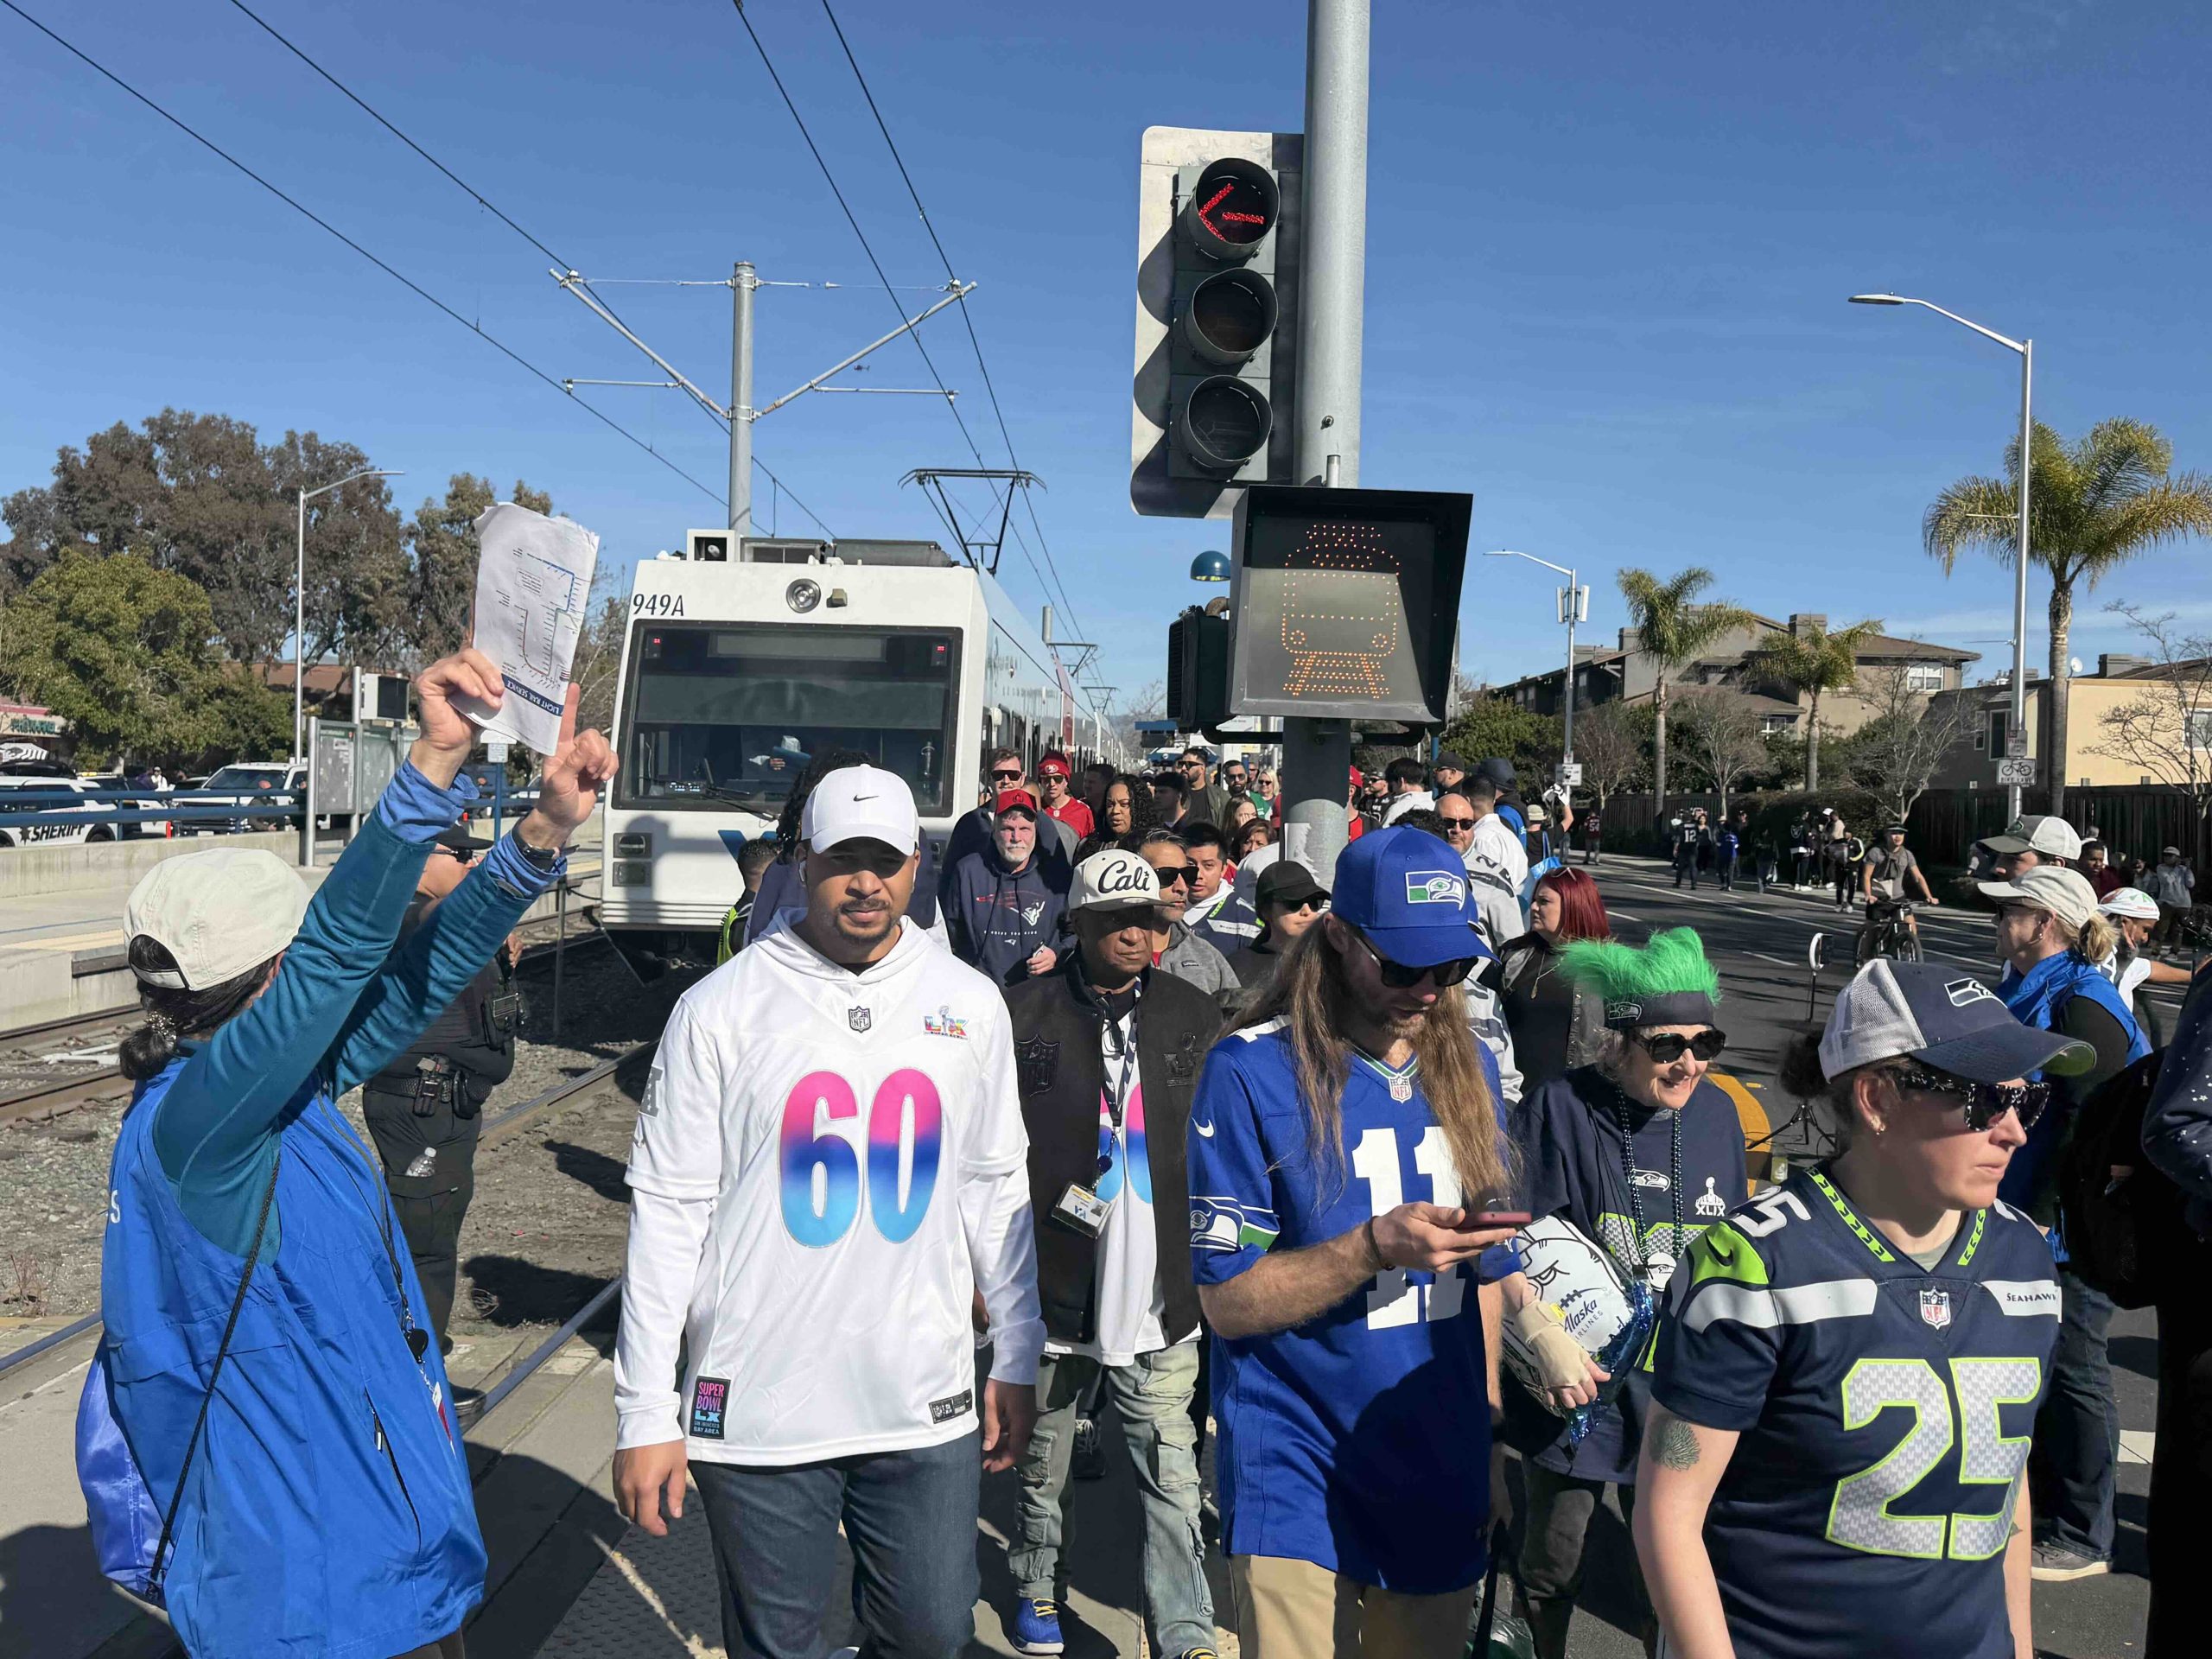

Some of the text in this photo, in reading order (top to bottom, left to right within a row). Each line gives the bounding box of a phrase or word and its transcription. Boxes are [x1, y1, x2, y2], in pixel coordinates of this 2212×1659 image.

[632, 593, 684, 616] 949A
[541, 700, 560, 715] LIGHT
[30, 823, 86, 842] SHERIFF
[1684, 830, 1697, 842] 12
[1097, 860, 1150, 893] Cali
[1393, 1085, 1410, 1097] NFL
[779, 1066, 943, 1249] 60
[1695, 1205, 1726, 1217] XLIX
[1351, 1125, 1466, 1331] 11
[1564, 1299, 1598, 1333] Alaska
[1925, 1305, 1946, 1323] NFL
[1574, 1310, 1604, 1340] IRLINES
[698, 1381, 725, 1397] SUPER
[696, 1395, 722, 1413] BOWL
[695, 1409, 721, 1423] LX
[1825, 1357, 2042, 1560] 25
